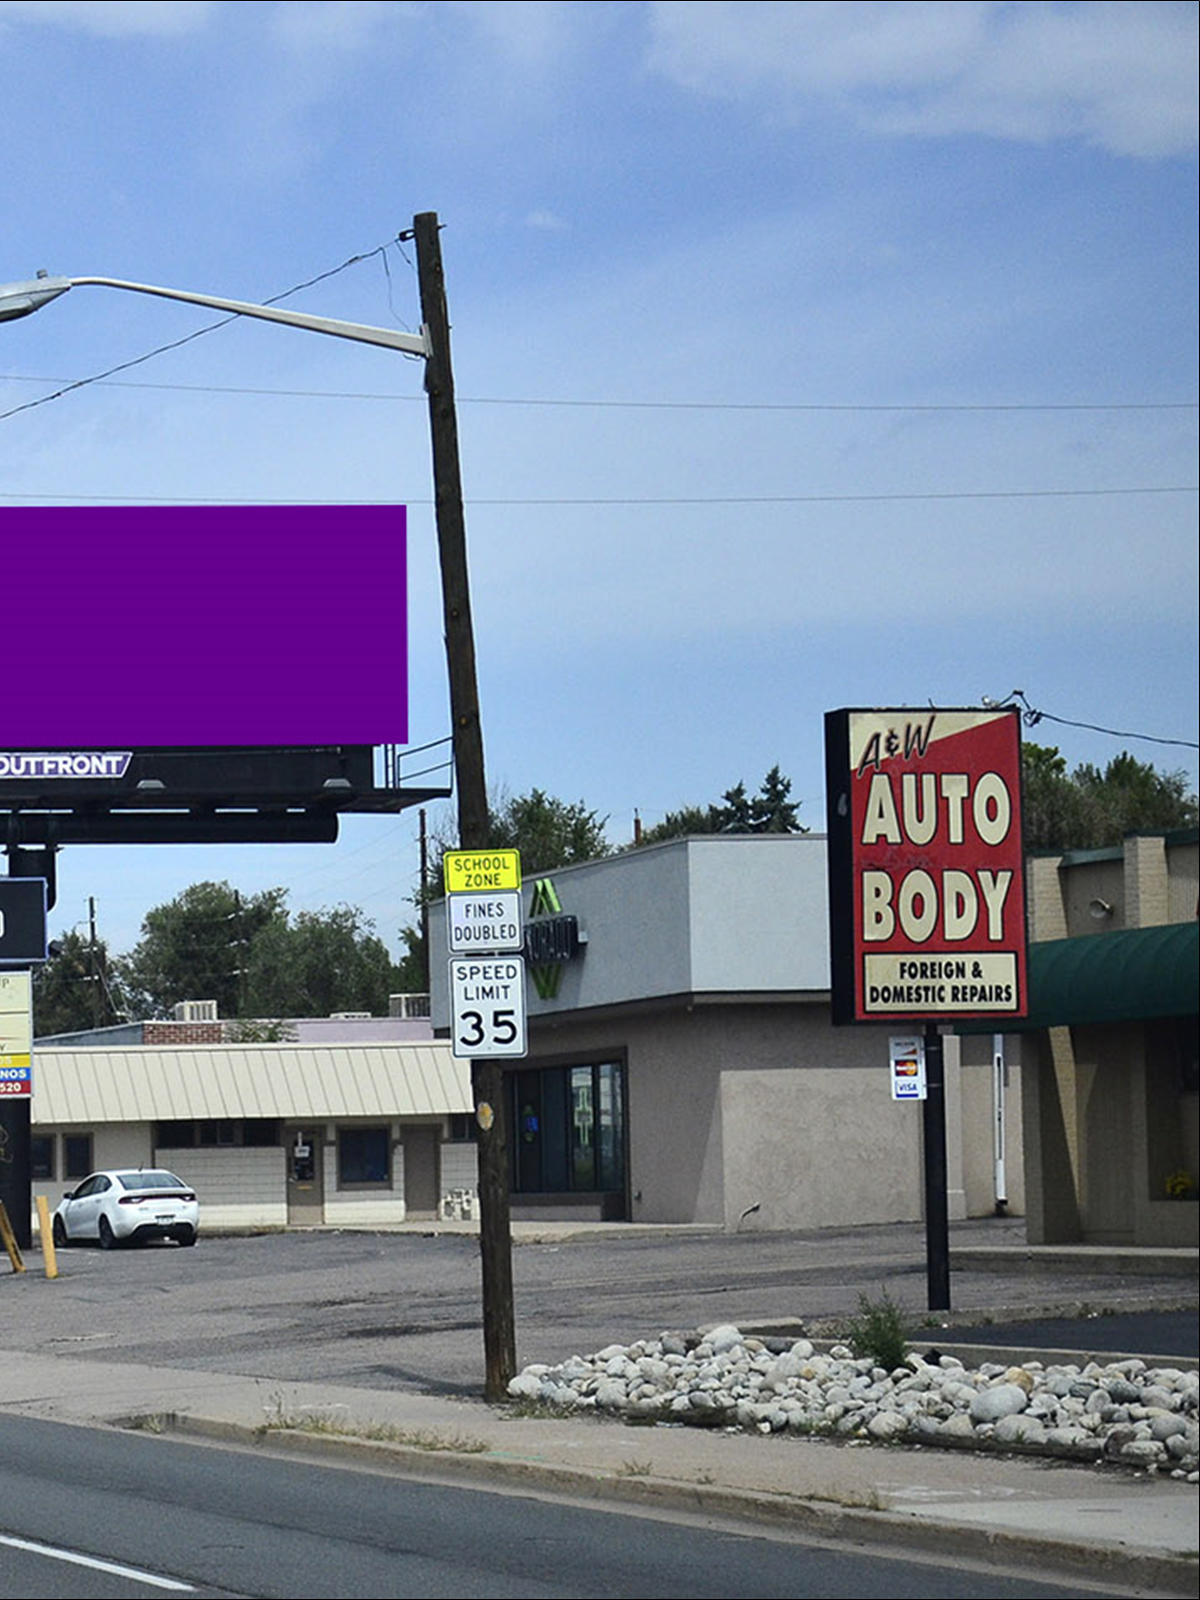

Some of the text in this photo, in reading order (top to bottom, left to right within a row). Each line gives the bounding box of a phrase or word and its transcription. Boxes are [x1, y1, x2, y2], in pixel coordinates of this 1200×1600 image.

[856, 715, 936, 778] A&W
[861, 771, 1011, 846] AUTO
[454, 857, 510, 872] SCHOOL
[464, 873, 502, 887] ZONE
[464, 902, 505, 918] FINES
[861, 869, 1014, 943] BODY
[454, 924, 517, 942] DOUBLED
[456, 965, 518, 981] SPEED
[899, 961, 983, 980] FOREIGN &
[463, 985, 511, 1001] LIMIT
[870, 983, 1013, 1004] DOMESTIC REPAIRS
[459, 1010, 518, 1046] 35
